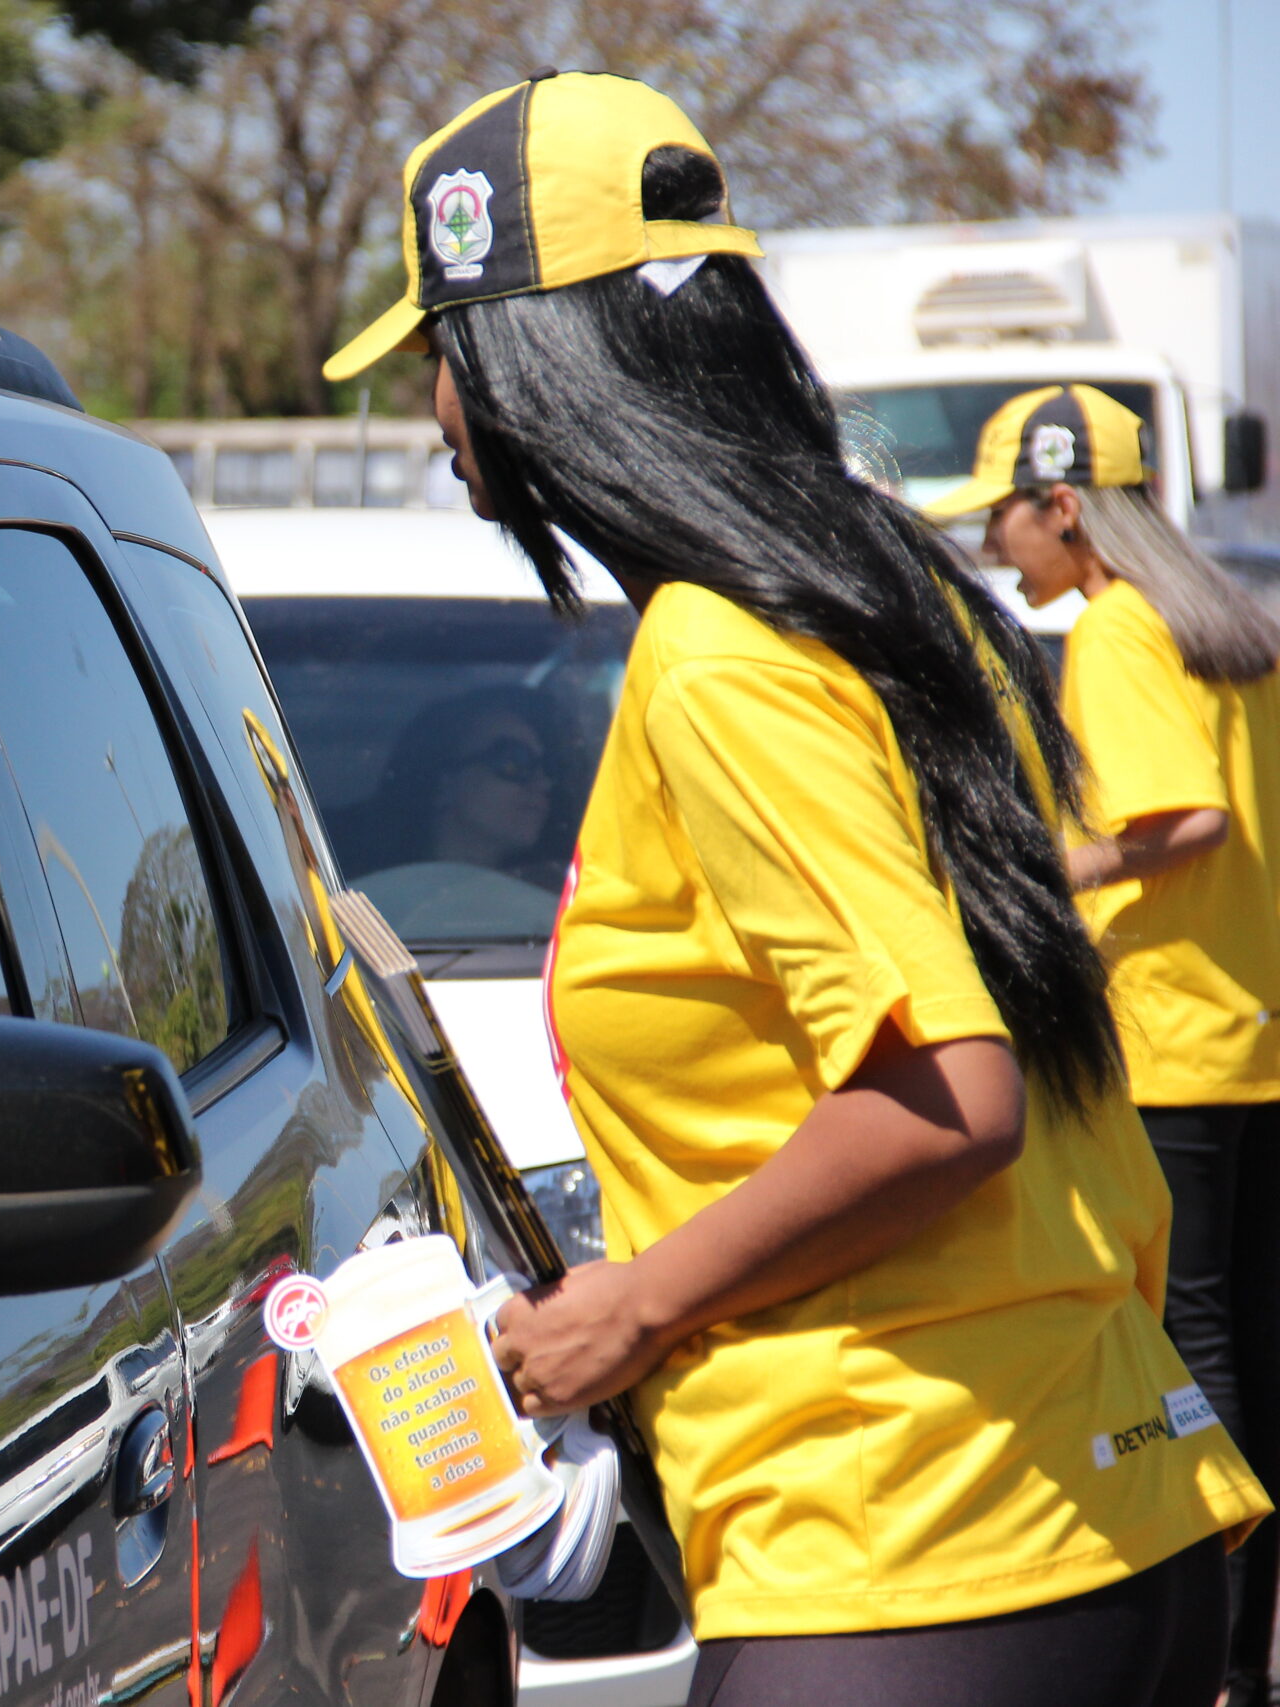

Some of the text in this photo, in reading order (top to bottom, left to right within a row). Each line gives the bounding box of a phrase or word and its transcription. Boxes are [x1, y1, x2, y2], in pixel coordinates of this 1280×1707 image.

[370, 1337, 449, 1382] Os efeitos
[383, 1357, 455, 1403] do álcool
[380, 1378, 476, 1432] não acabam
[408, 1410, 467, 1447] quando
[415, 1431, 479, 1468] termina
[431, 1456, 484, 1489] a dose
